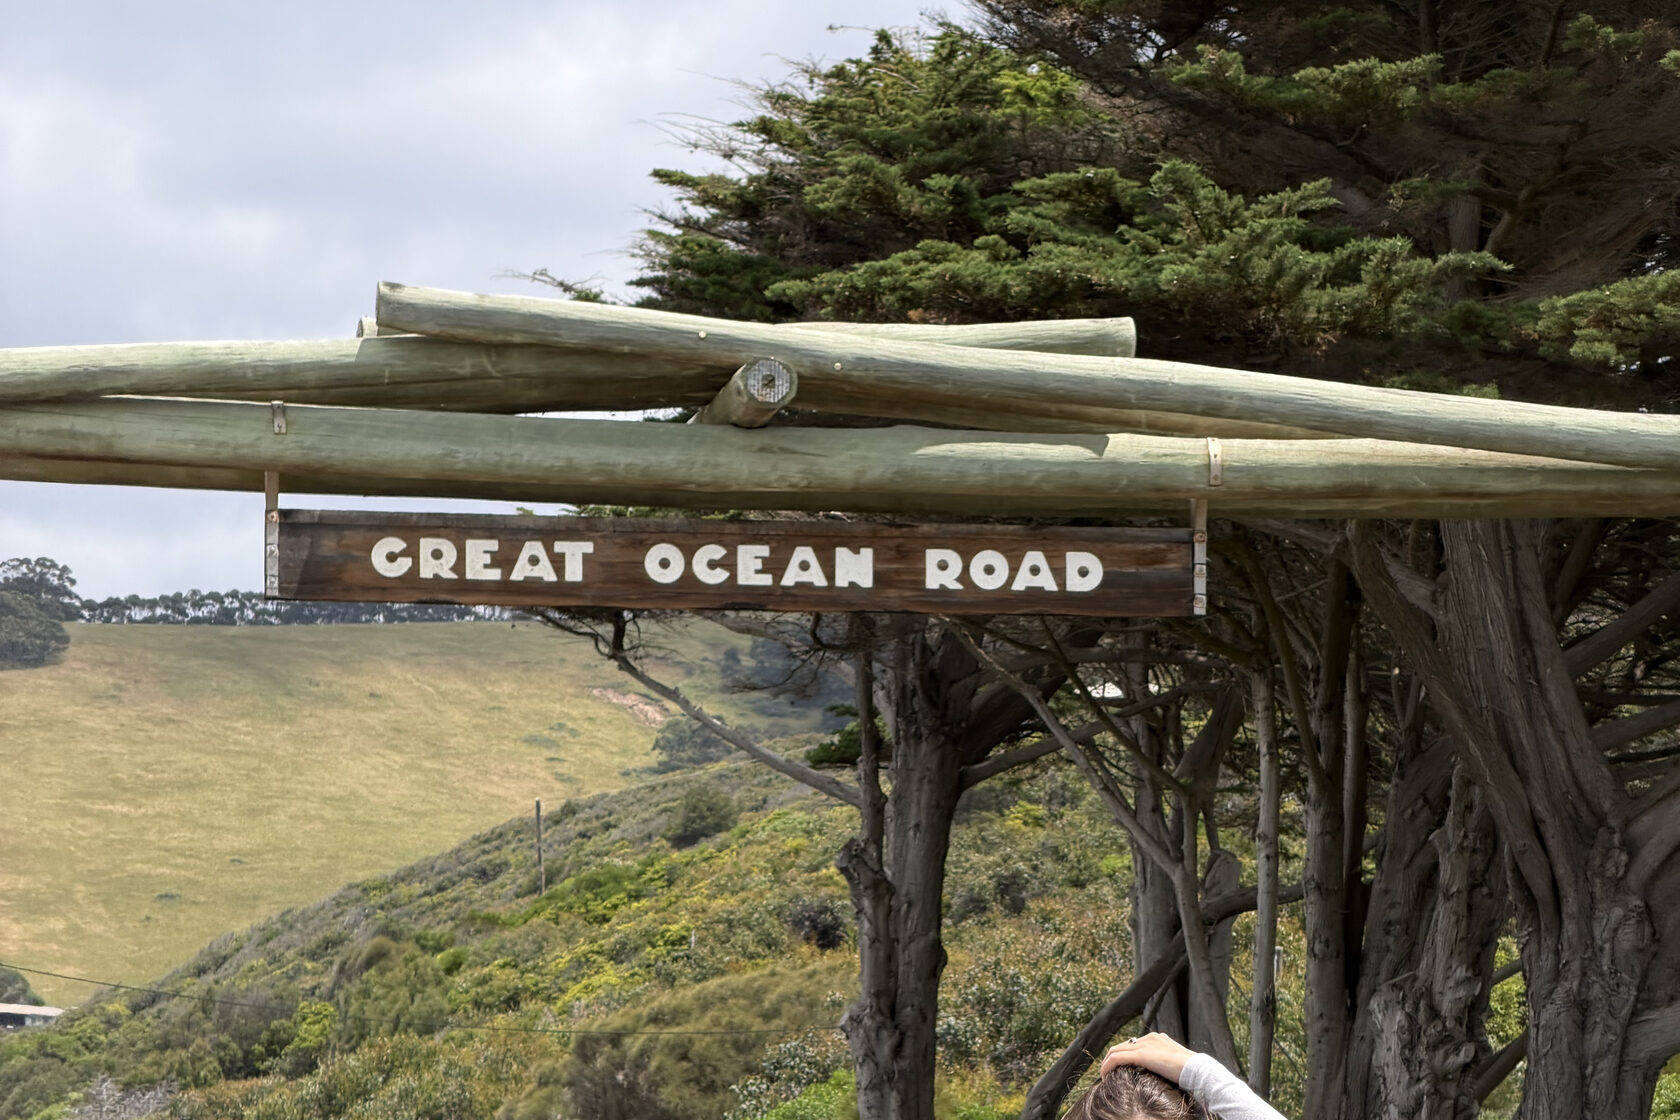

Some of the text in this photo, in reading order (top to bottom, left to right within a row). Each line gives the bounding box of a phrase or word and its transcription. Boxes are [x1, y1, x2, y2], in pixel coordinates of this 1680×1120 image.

[371, 537, 1103, 593] GREAT OCEAN ROAD
